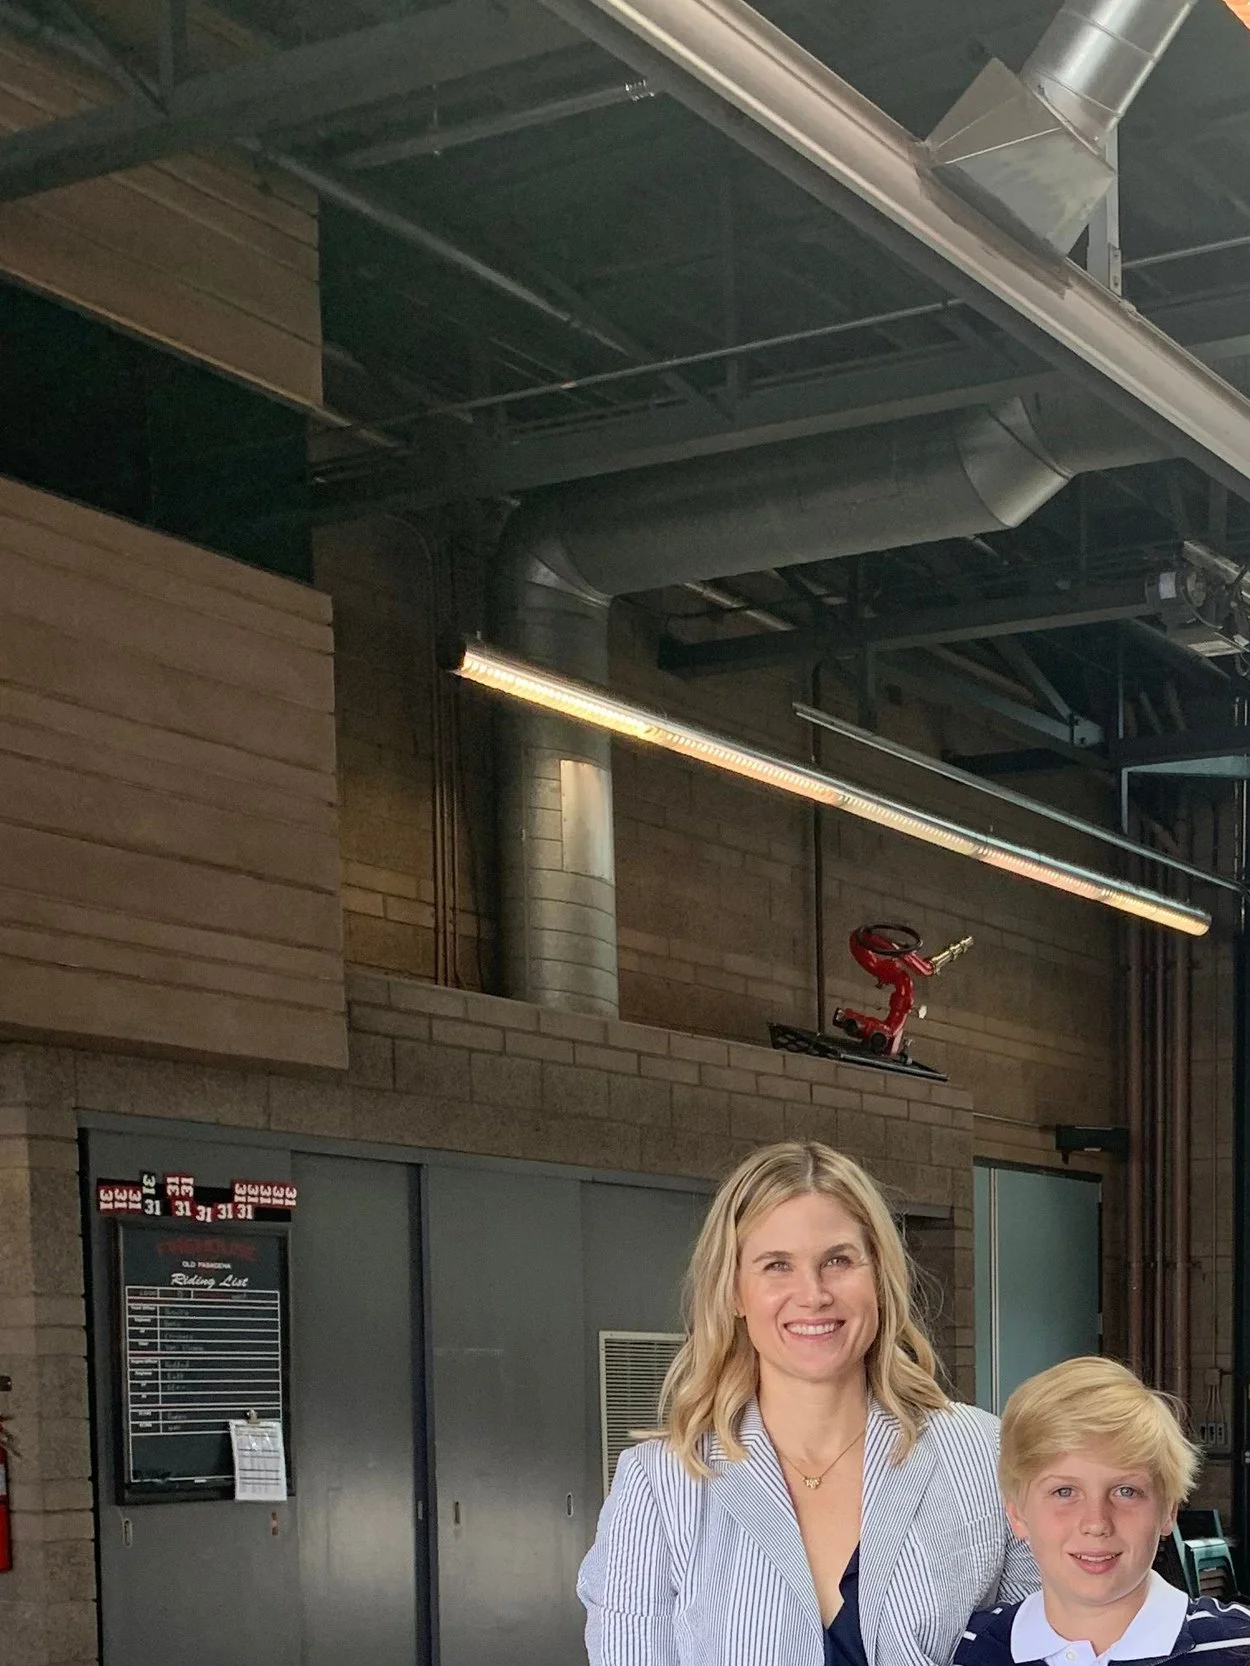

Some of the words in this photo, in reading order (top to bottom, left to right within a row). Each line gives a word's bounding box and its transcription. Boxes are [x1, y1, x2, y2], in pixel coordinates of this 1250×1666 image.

[143, 1174, 156, 1195] 31
[167, 1176, 179, 1196] 31
[181, 1177, 194, 1197] 31
[234, 1183, 246, 1202] 31
[248, 1184, 259, 1203] 31
[100, 1188, 113, 1209] 31
[114, 1188, 127, 1209] 31
[129, 1189, 142, 1209] 31
[260, 1185, 272, 1204] 31
[272, 1186, 284, 1205] 31
[285, 1187, 297, 1206] 31
[144, 1199, 161, 1216] 31
[175, 1200, 192, 1216] 31
[196, 1205, 212, 1222] 31
[217, 1203, 233, 1219] 31
[237, 1203, 253, 1220] 31
[182, 1260, 196, 1268] OLD
[171, 1273, 216, 1289] Riding
[219, 1274, 249, 1287] List
